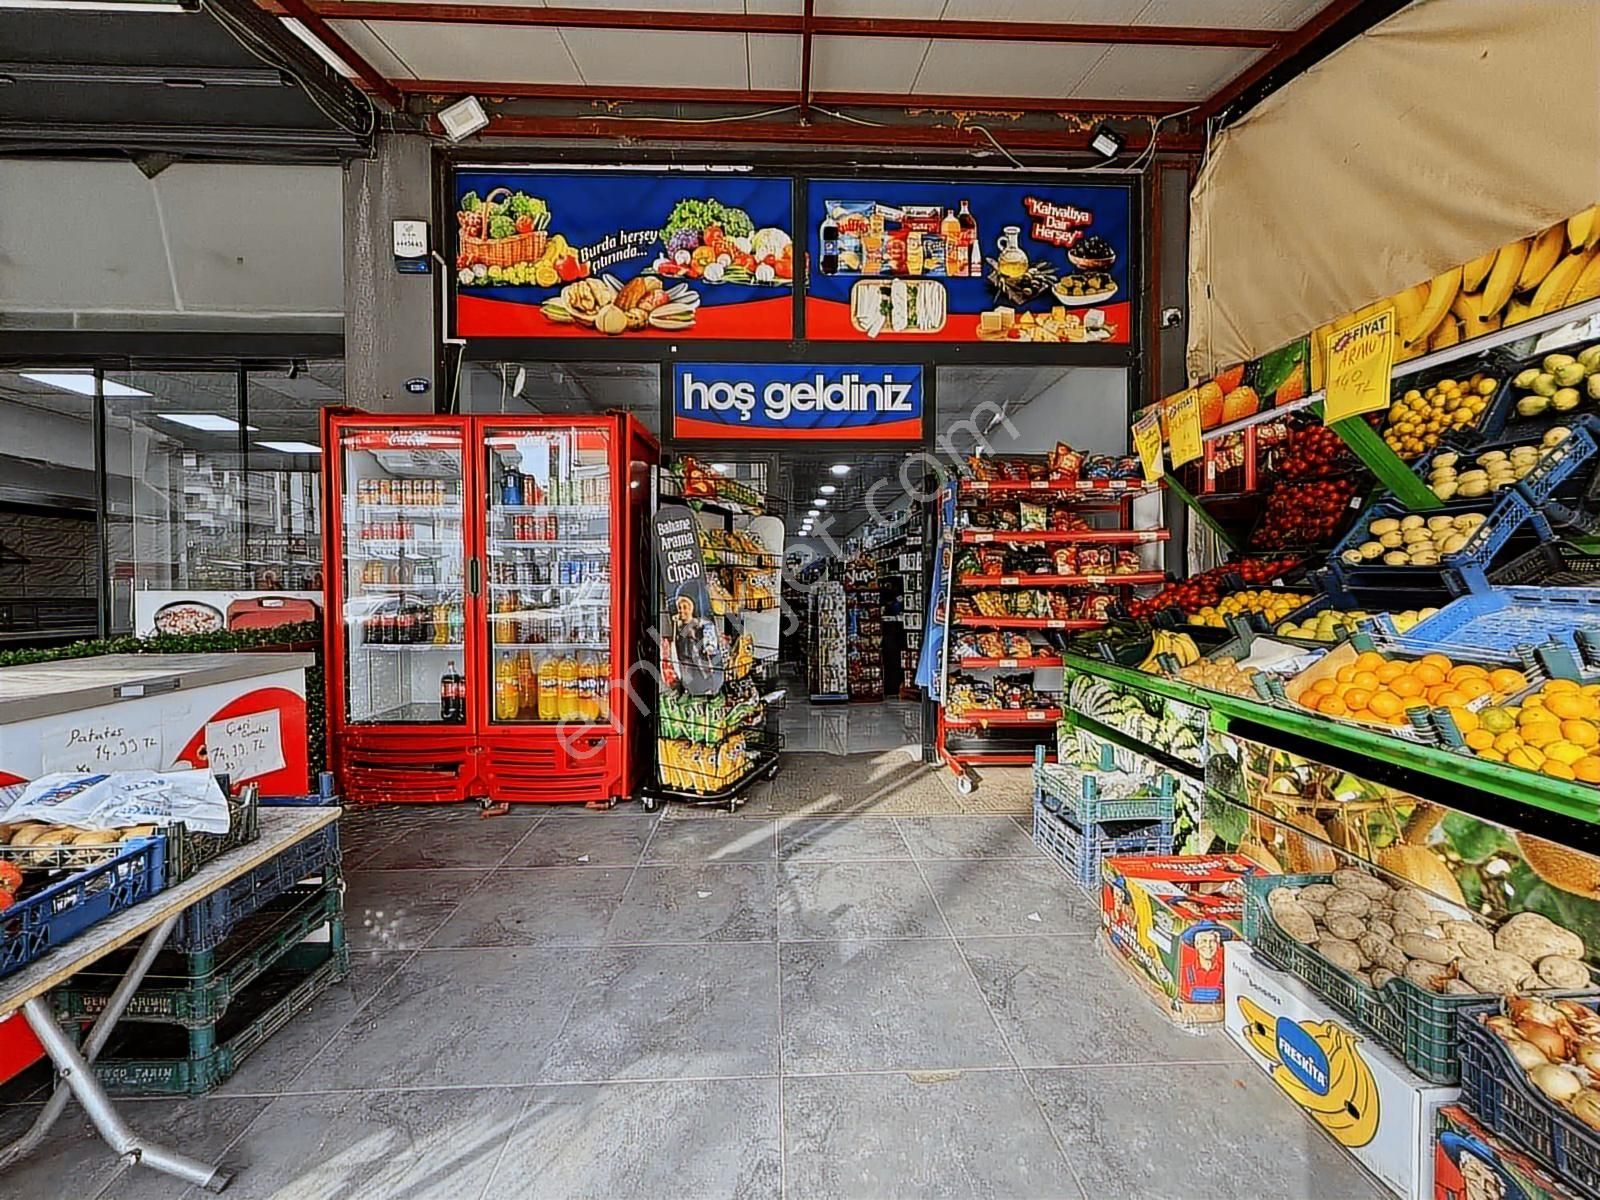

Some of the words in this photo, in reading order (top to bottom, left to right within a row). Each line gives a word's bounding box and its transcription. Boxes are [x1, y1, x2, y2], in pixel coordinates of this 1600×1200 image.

[1046, 215, 1071, 230] Dair
[580, 235, 616, 262] Burda
[620, 230, 658, 245] herşey
[1353, 315, 1388, 341] FİYAT
[683, 373, 756, 421] hoş
[764, 374, 912, 420] geldiniz
[657, 518, 692, 536] Bahane
[661, 532, 695, 552] Arama
[667, 562, 700, 584] Cipso
[66, 727, 125, 747] Patates
[96, 738, 138, 761] 14.99
